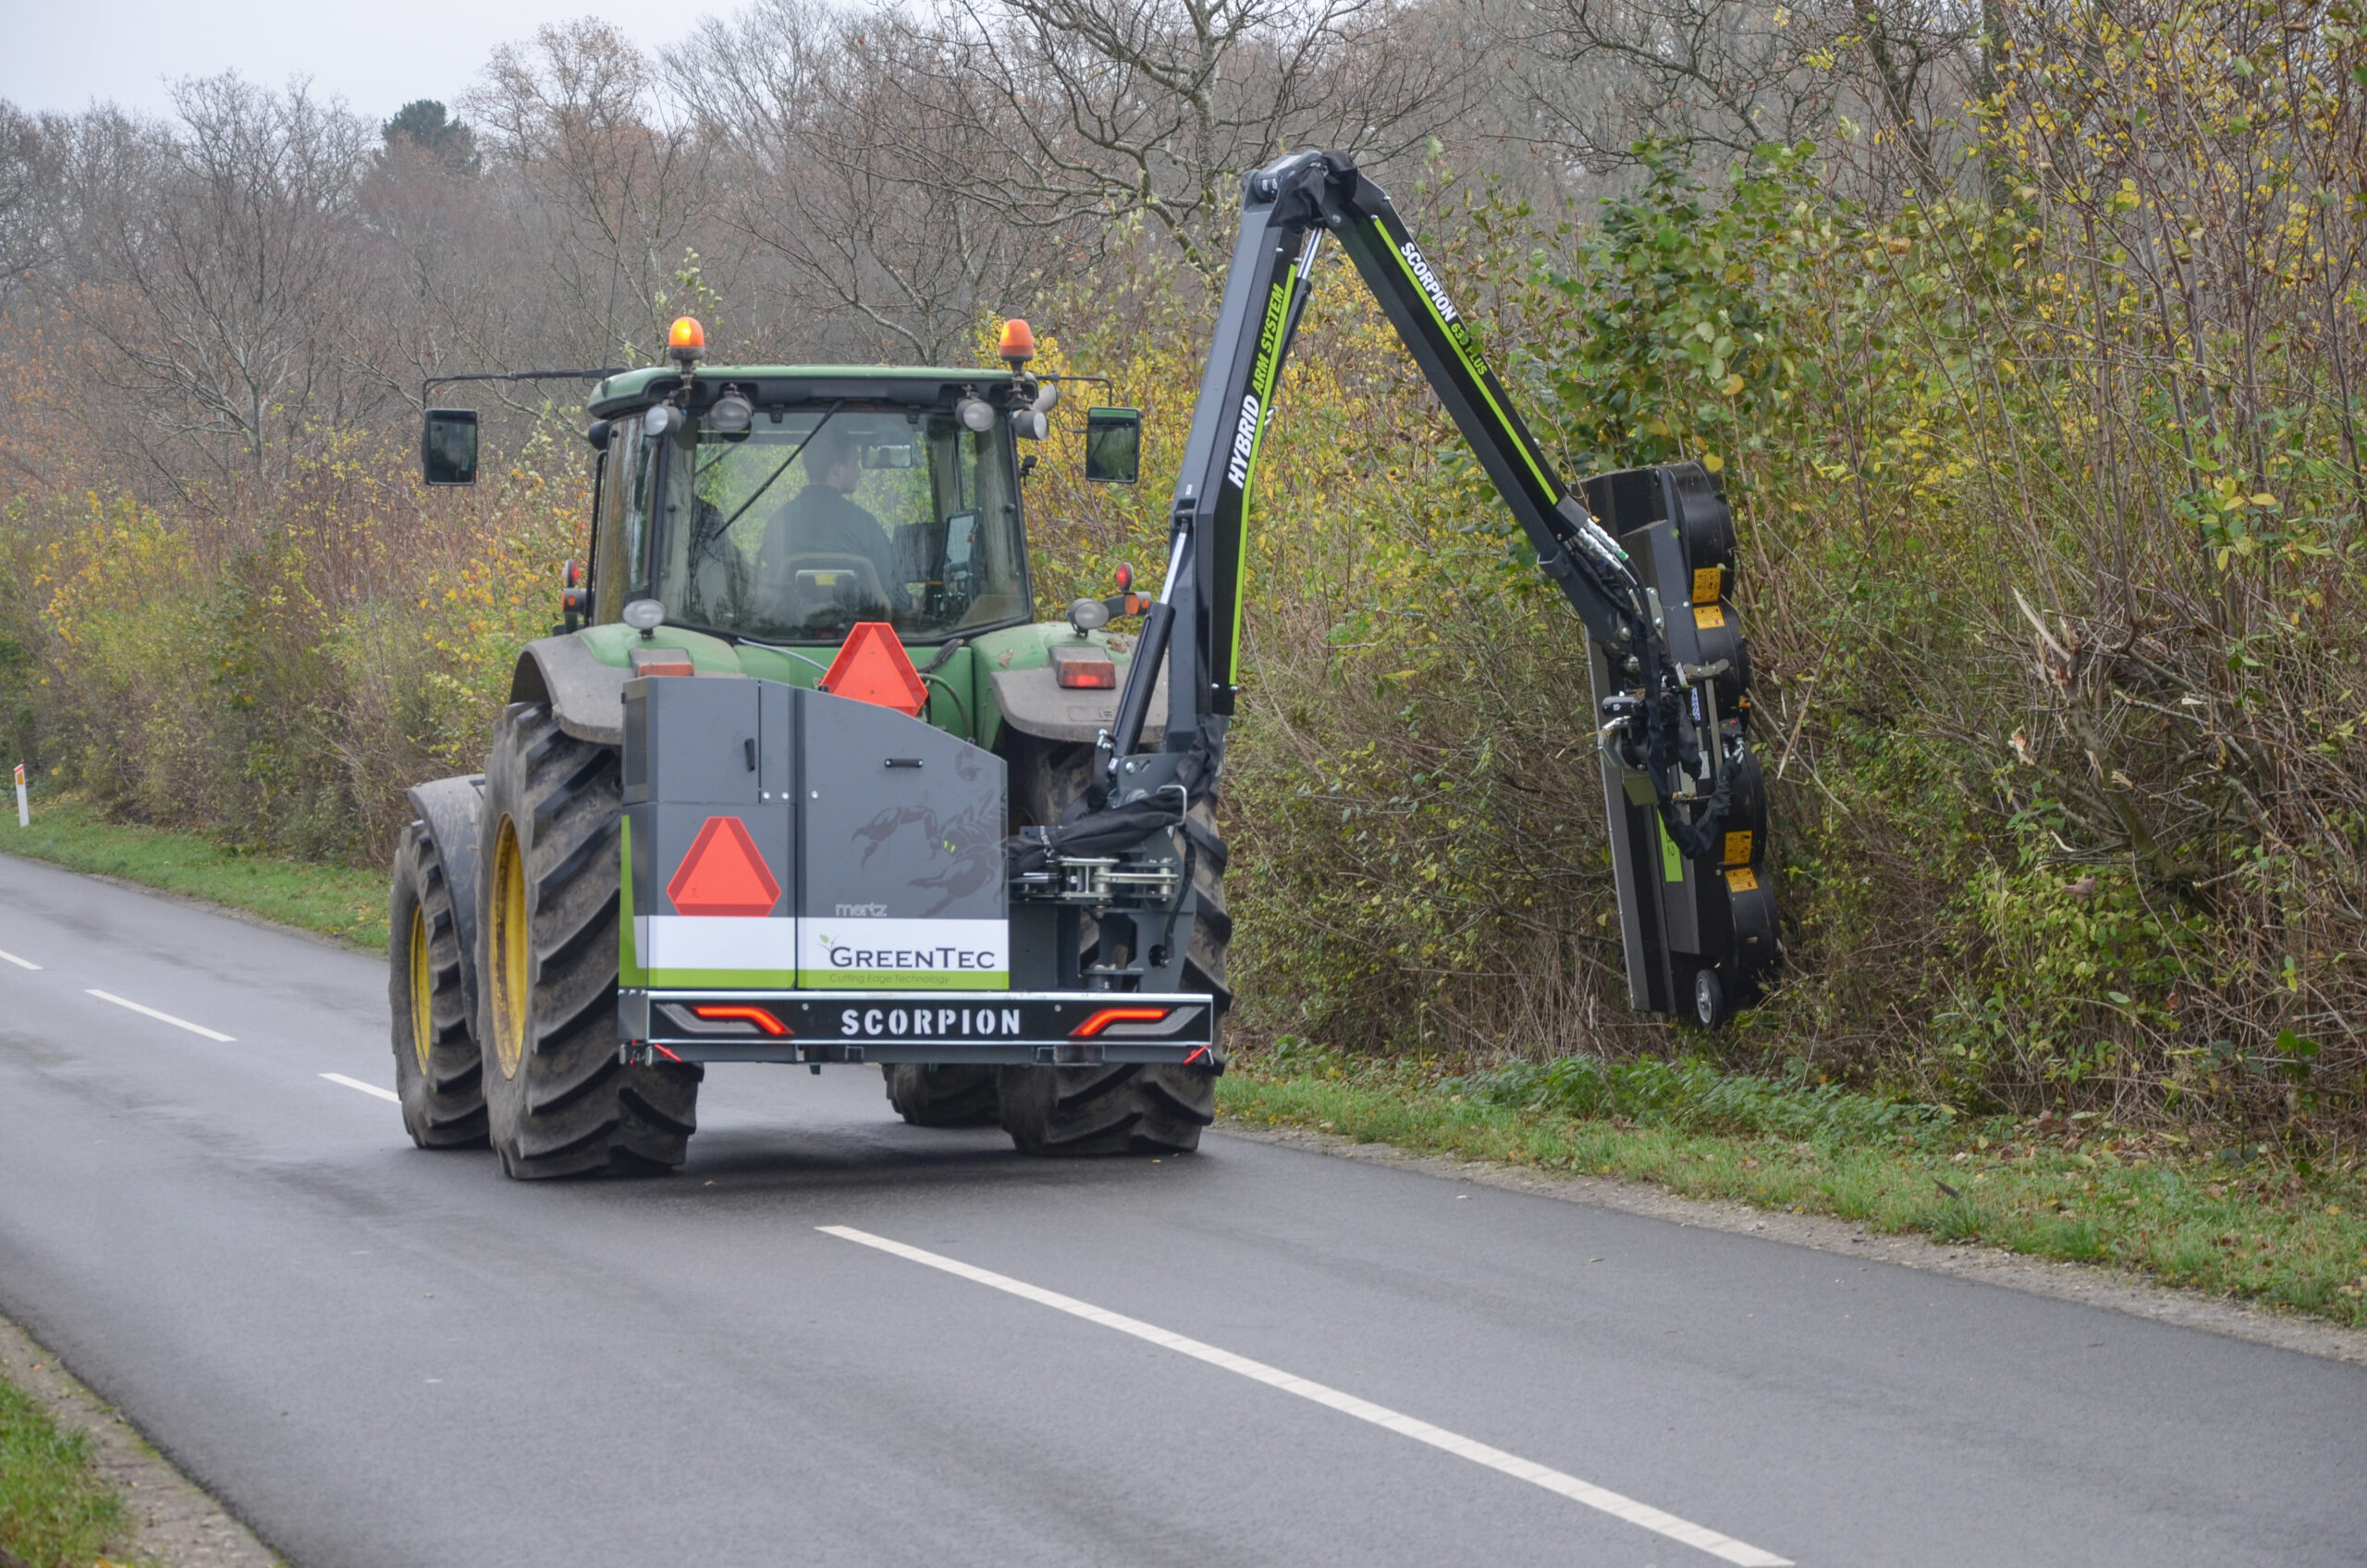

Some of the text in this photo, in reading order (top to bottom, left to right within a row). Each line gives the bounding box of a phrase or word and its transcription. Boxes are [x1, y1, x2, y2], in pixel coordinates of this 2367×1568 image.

[1401, 241, 1457, 322] SCORPION
[1228, 282, 1285, 490] HYBRID ARM SYSTEM
[829, 974, 950, 986] Cutting Edge Technology
[840, 1009, 1021, 1035] SCORPION
